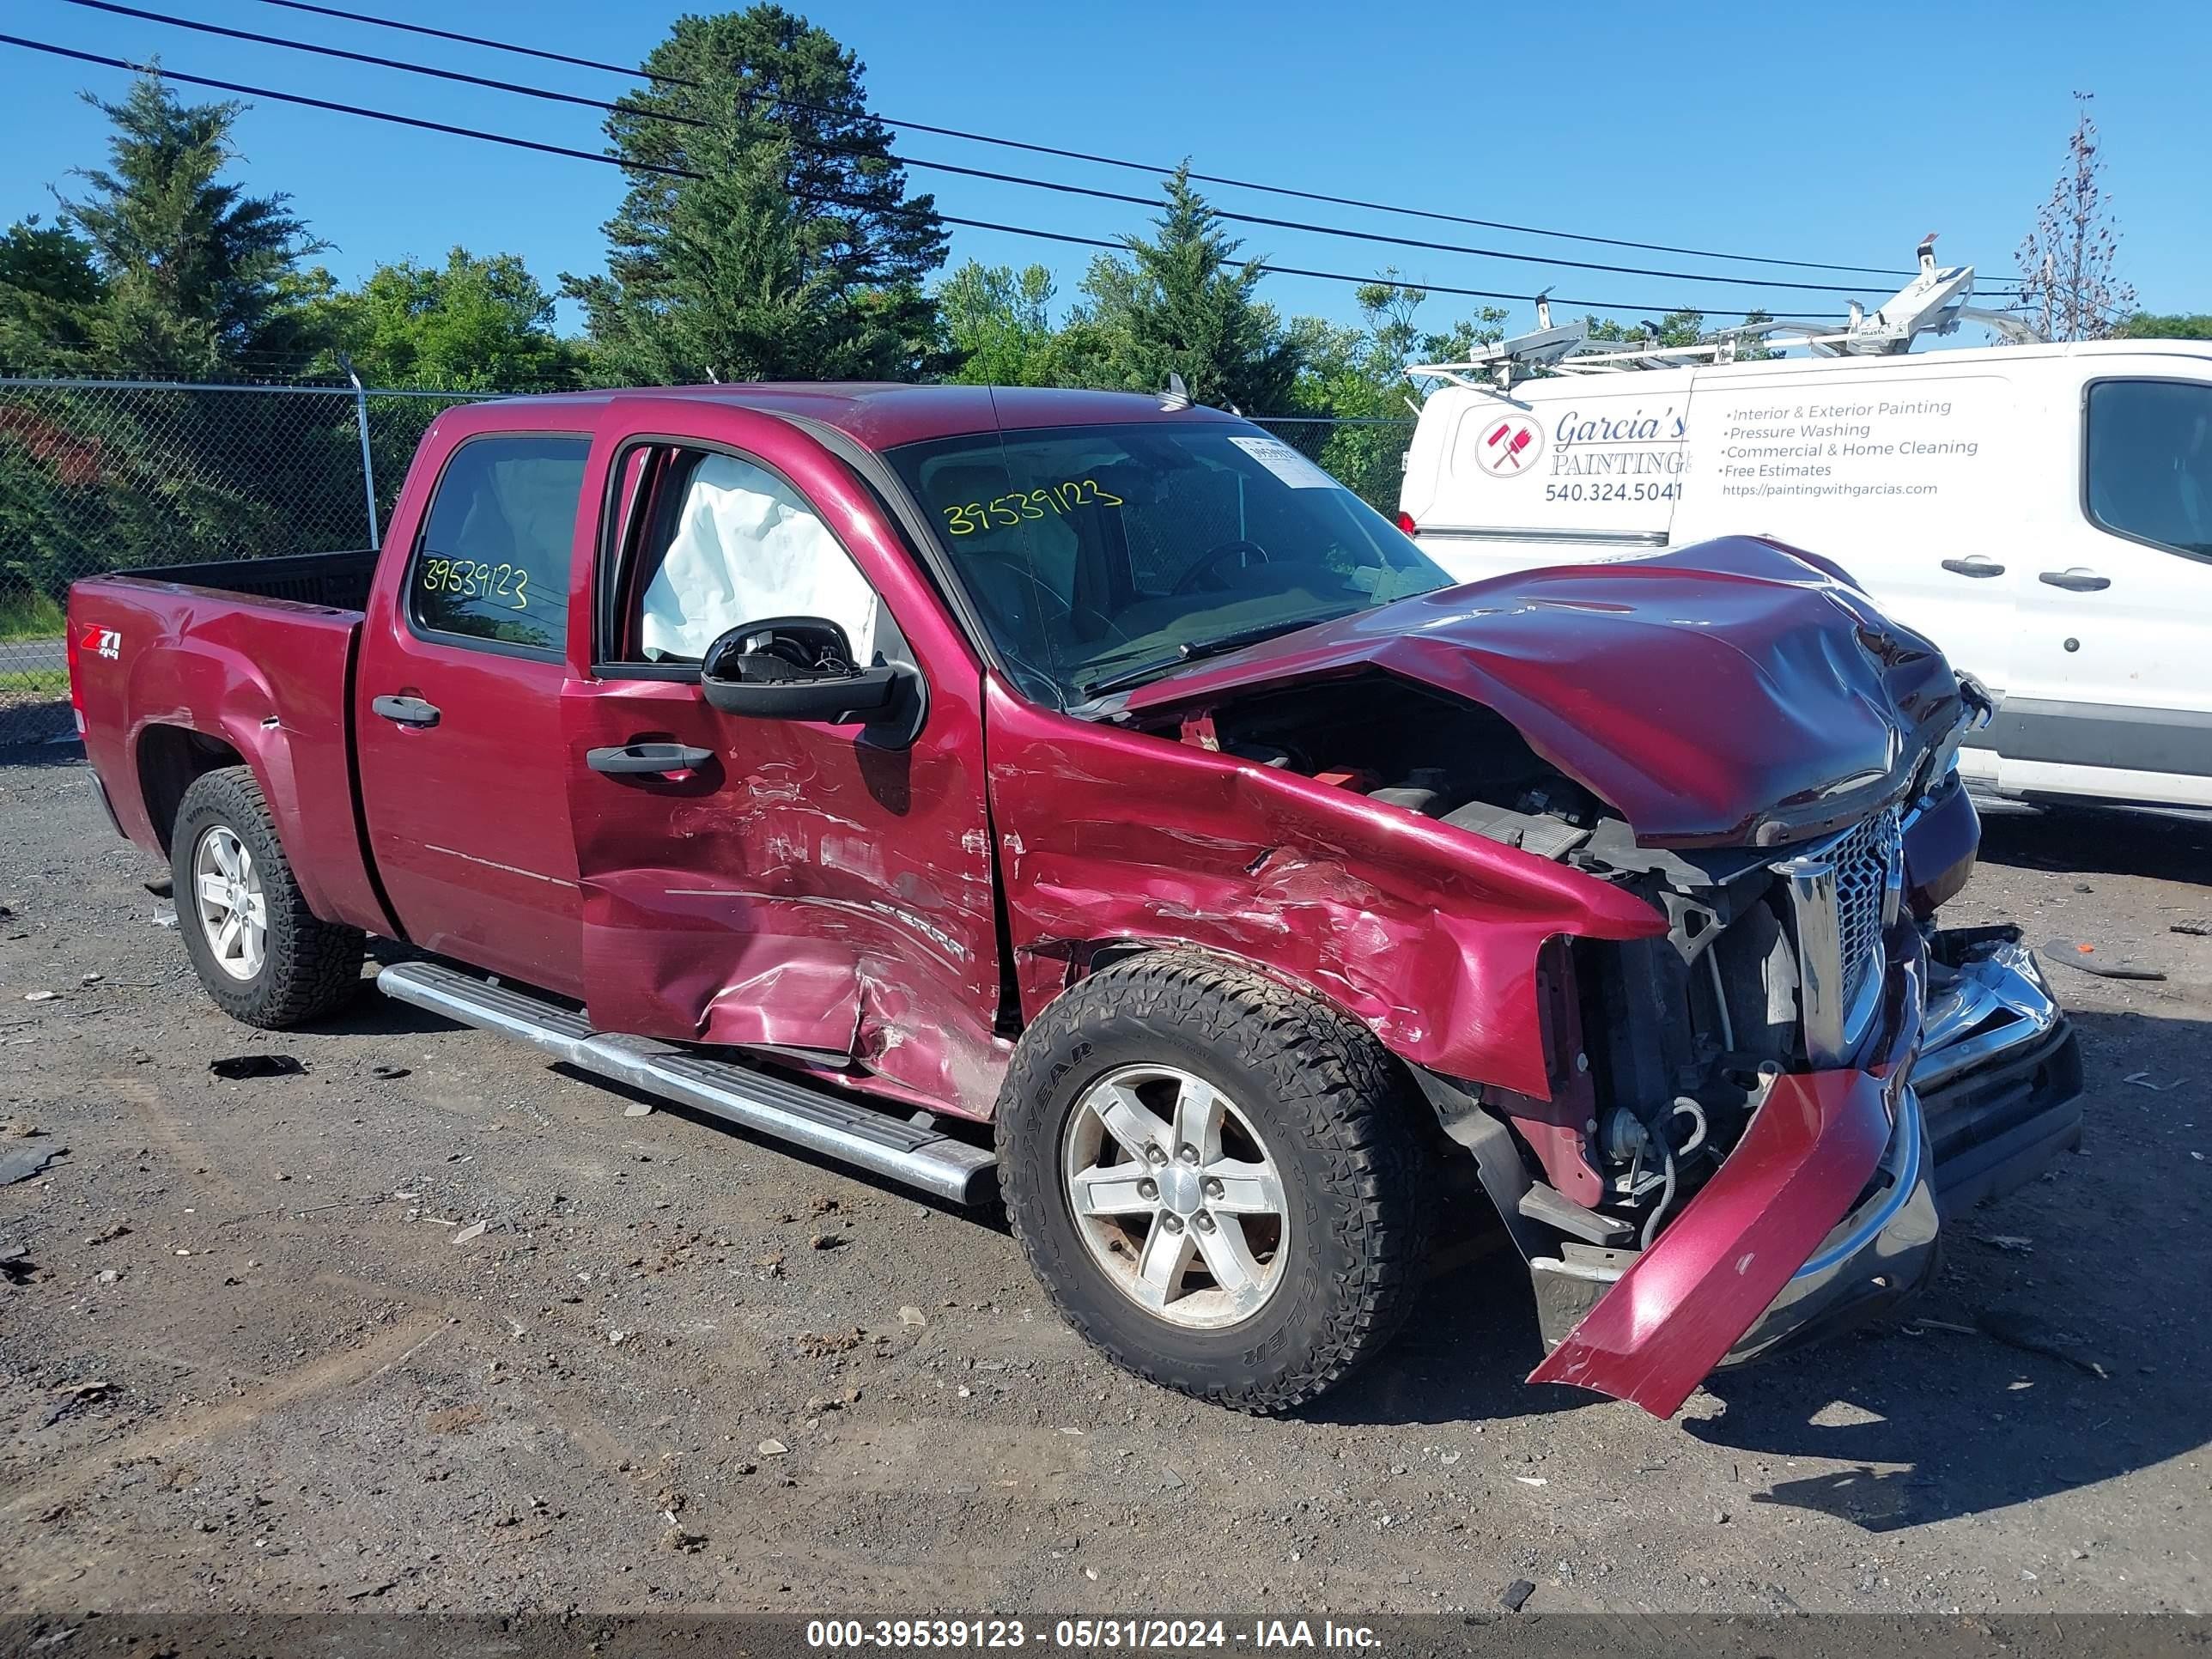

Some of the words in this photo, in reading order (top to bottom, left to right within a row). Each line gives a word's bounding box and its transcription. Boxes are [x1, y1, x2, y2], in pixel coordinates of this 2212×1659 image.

[1732, 405, 1789, 421] Interior
[1794, 405, 1804, 418] &
[1808, 403, 1874, 418] Exterior
[1878, 399, 1952, 416] Painting
[1555, 407, 1690, 453] Garcia's
[1729, 427, 1795, 440] Pressure
[1800, 423, 1870, 439] Washing
[1727, 443, 1822, 458] Commercial
[1827, 444, 1838, 456] &
[1843, 442, 1894, 456] Home
[1899, 440, 1978, 457] Cleaning
[1550, 452, 1684, 476] PAINTING
[1725, 465, 1755, 477] Free
[1759, 463, 1832, 477] Estimates
[1546, 483, 1683, 501] 540.324.5041
[1723, 483, 1938, 497] https://paintingwithgarcias.com
[943, 479, 1123, 535] 39539123
[424, 559, 528, 609] 39539123
[81, 623, 121, 650] Z71
